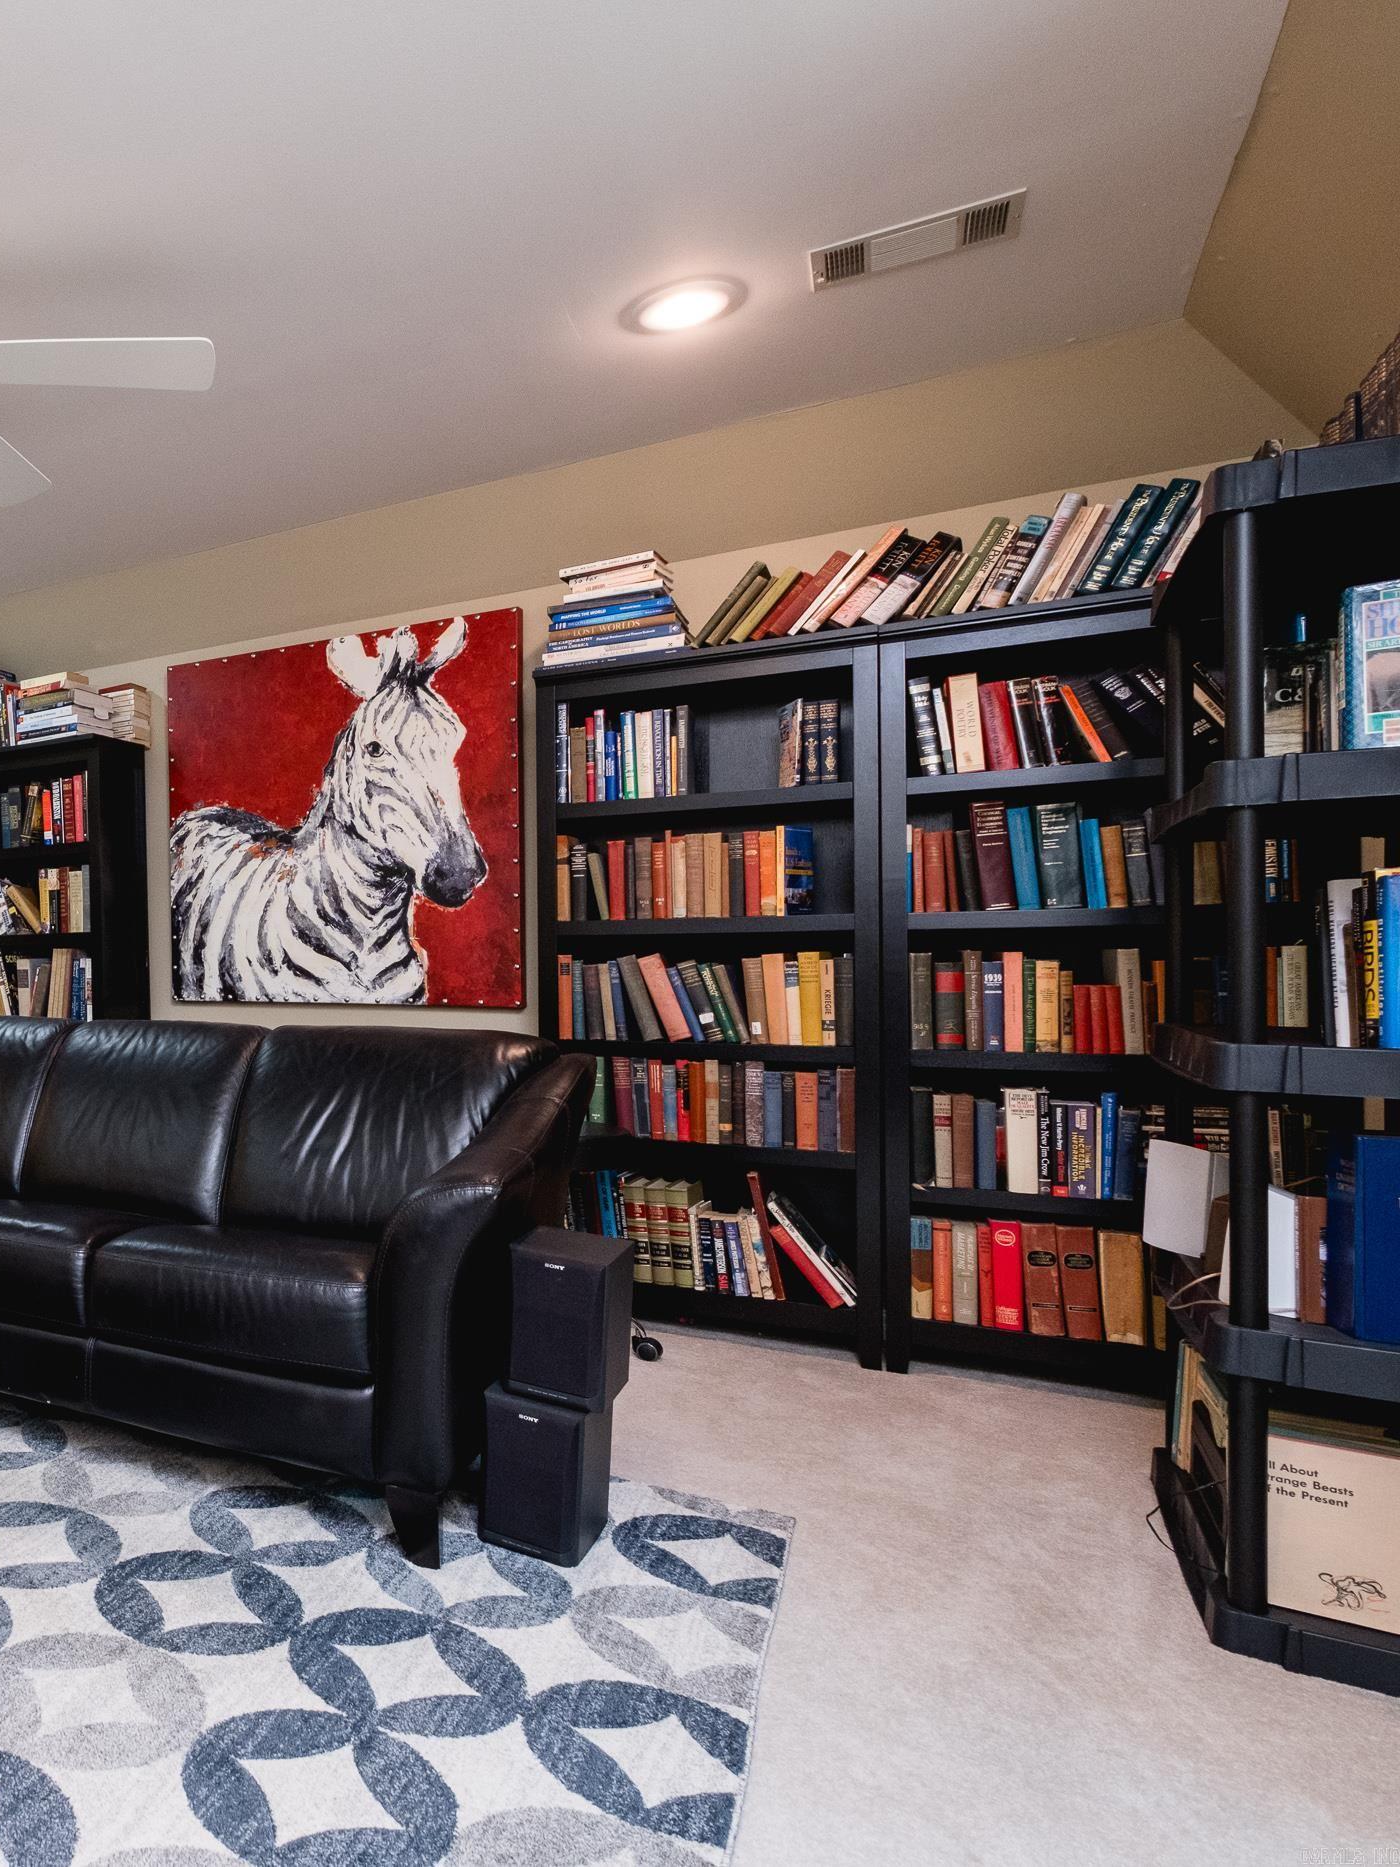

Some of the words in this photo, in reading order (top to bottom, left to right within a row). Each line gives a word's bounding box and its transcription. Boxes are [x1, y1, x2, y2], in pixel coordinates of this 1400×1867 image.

[996, 527, 1013, 550] Total
[879, 541, 908, 571] FOLLETT
[893, 550, 910, 568] KEN
[911, 539, 940, 568] FOLLETT
[924, 549, 942, 564] KEN
[980, 551, 1000, 574] Poker
[599, 620, 640, 633] WORLDS
[558, 637, 592, 645] CARTOGRAPHY
[967, 701, 977, 738] WORLD
[654, 720, 662, 760] REVOLUTION
[1265, 840, 1278, 878] EMISTRY
[1363, 929, 1376, 1005] BIRDS
[984, 973, 1002, 982] 1939
[824, 989, 832, 1015] KRIEGIE
[1040, 1117, 1049, 1129] The
[1041, 1131, 1049, 1145] New
[1055, 1127, 1064, 1150] Harris-Perry
[1040, 1145, 1050, 1157] Jim
[1041, 1158, 1050, 1176] Crow
[714, 1238, 724, 1251] JAMES
[715, 1250, 726, 1274] PATTERSON
[719, 1275, 728, 1290] SAIL
[518, 1413, 539, 1423] SONY
[1268, 1460, 1276, 1470] ll
[1280, 1463, 1319, 1478] About
[1267, 1474, 1307, 1488] range
[1313, 1481, 1354, 1497] Beasts
[1276, 1488, 1296, 1498] the
[1301, 1491, 1349, 1508] Present
